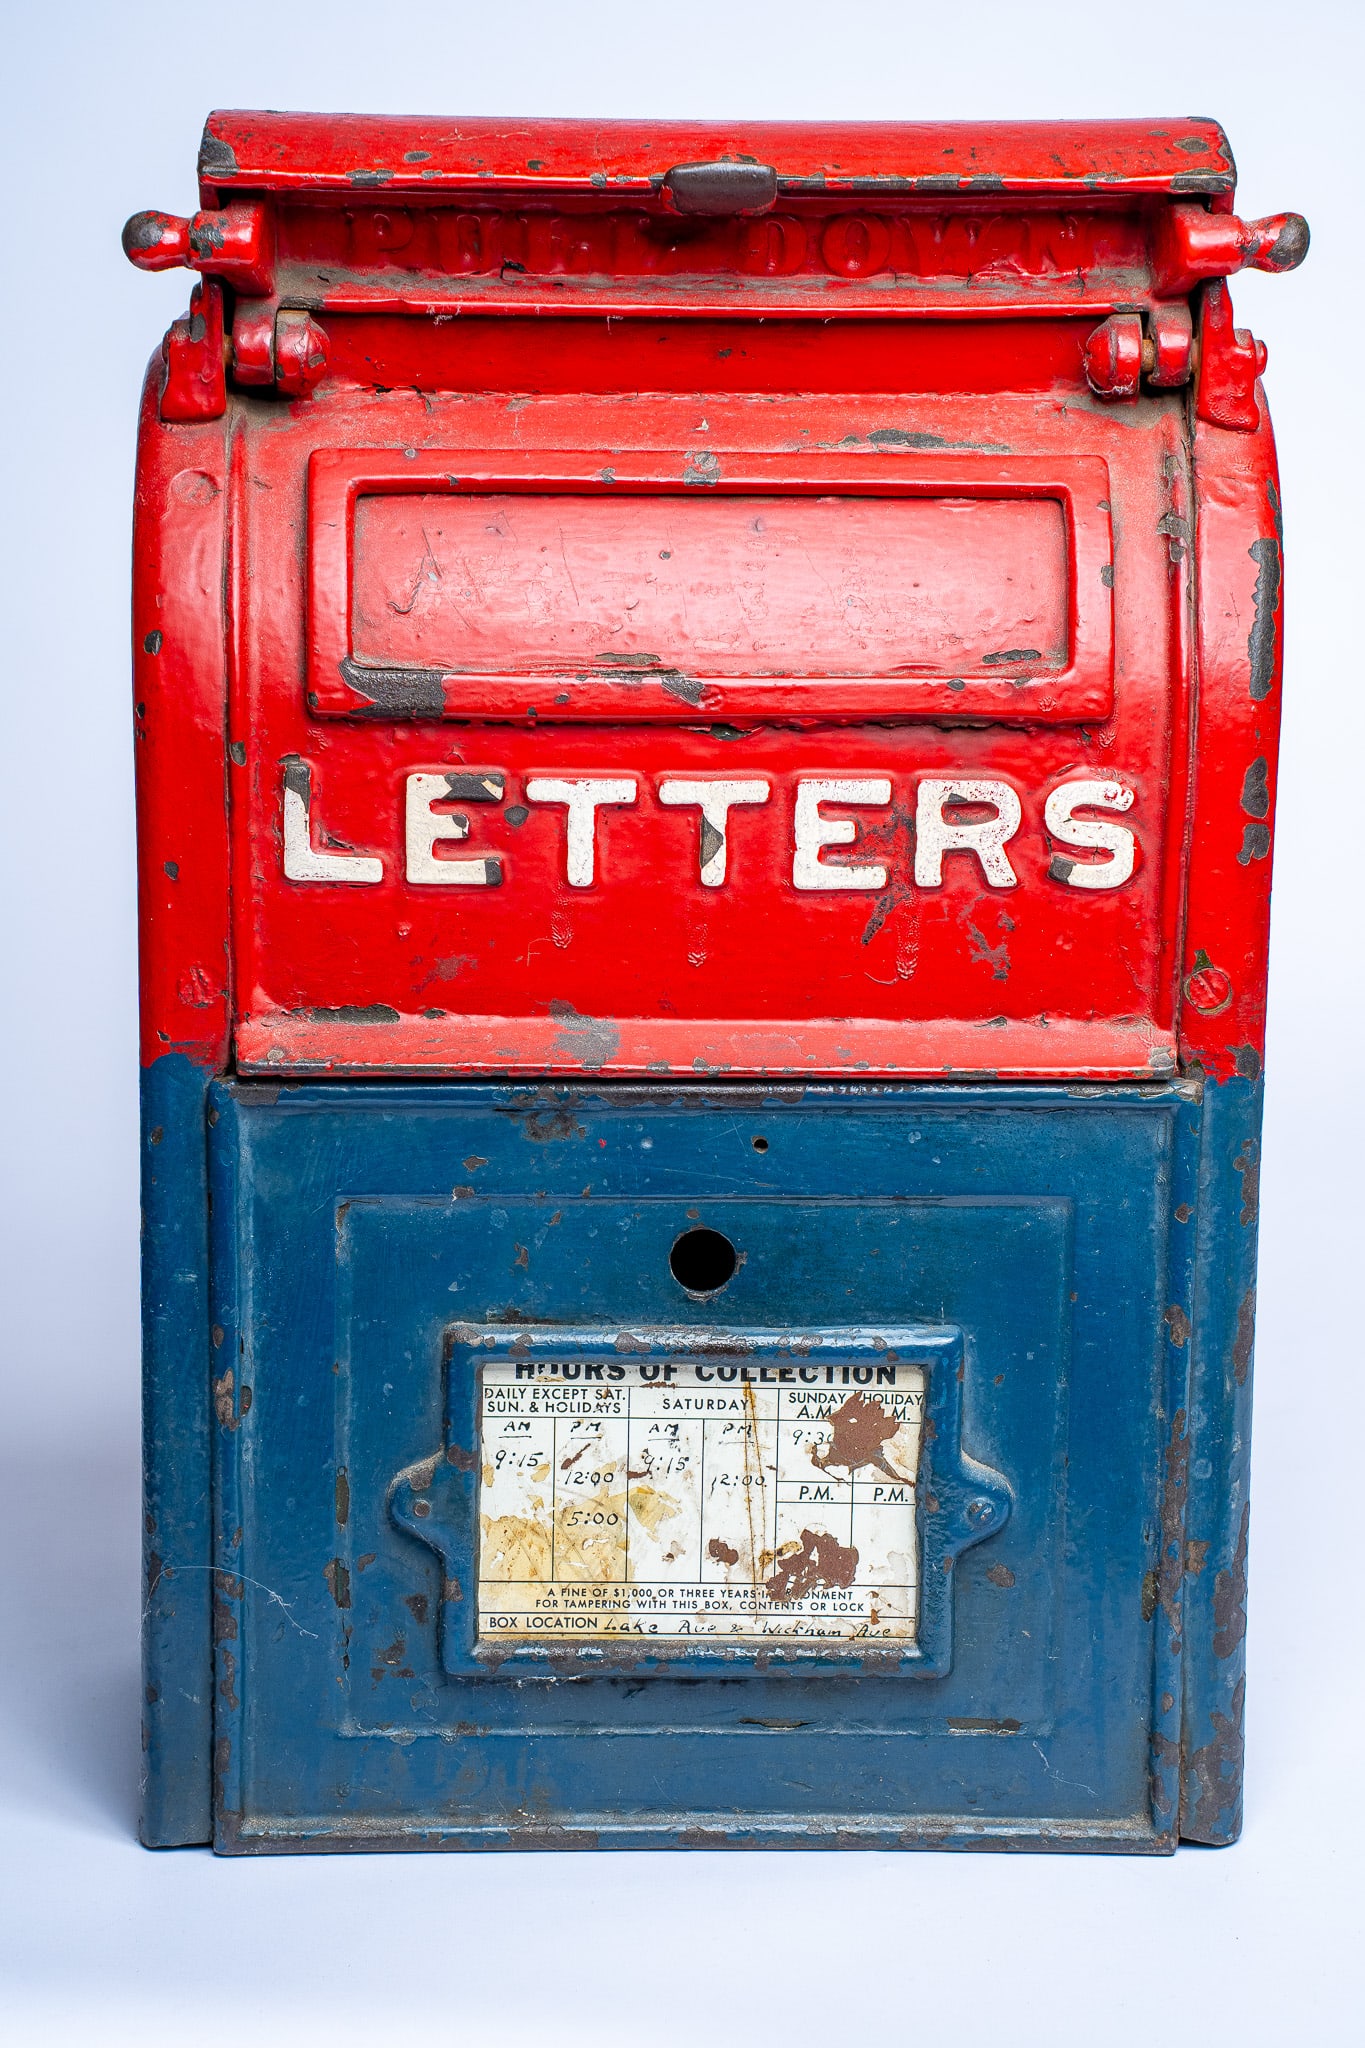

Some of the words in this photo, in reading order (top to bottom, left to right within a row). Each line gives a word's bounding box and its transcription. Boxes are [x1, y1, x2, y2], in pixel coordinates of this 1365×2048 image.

[746, 206, 1100, 278] DOWN
[283, 763, 1135, 890] LETTERS
[640, 1364, 678, 1382] OF
[695, 1365, 896, 1385] COLLECTION
[484, 1388, 527, 1400] DAILY
[532, 1388, 588, 1400] EXCEPT
[594, 1389, 626, 1401] SAT.
[788, 1391, 846, 1404] SUNDAY
[863, 1393, 923, 1406] HOLIDAY
[487, 1401, 524, 1413] SUN.
[529, 1402, 539, 1412] &
[545, 1402, 621, 1414] HOLIDAYS
[662, 1398, 749, 1411] SATURDAY
[796, 1404, 833, 1419] A.M
[495, 1449, 544, 1470] 9:15
[642, 1452, 690, 1475] 9:15
[564, 1471, 615, 1487] 12:00
[799, 1485, 835, 1501] P.M.
[873, 1487, 910, 1503] P.M.
[567, 1510, 619, 1527] 5:00
[547, 1588, 555, 1597] A
[561, 1588, 588, 1597] FINE
[592, 1588, 609, 1597] OF
[614, 1588, 653, 1599] $1,000
[658, 1589, 675, 1598] OR
[680, 1589, 715, 1598] THREE
[720, 1589, 757, 1599] YEARS
[535, 1599, 559, 1609] FOR
[564, 1599, 631, 1609] TAMPERING
[636, 1600, 667, 1609] WITH
[671, 1600, 699, 1609] THIS
[704, 1601, 733, 1611] BOX,
[739, 1601, 804, 1612] CONTENTS
[810, 1602, 827, 1612] OR
[833, 1603, 864, 1613] LOCK
[489, 1616, 518, 1629] BOX
[526, 1617, 598, 1629] LOCATION
[603, 1618, 659, 1634] Lake
[678, 1619, 717, 1634] Ave
[856, 1623, 892, 1638] Ave
